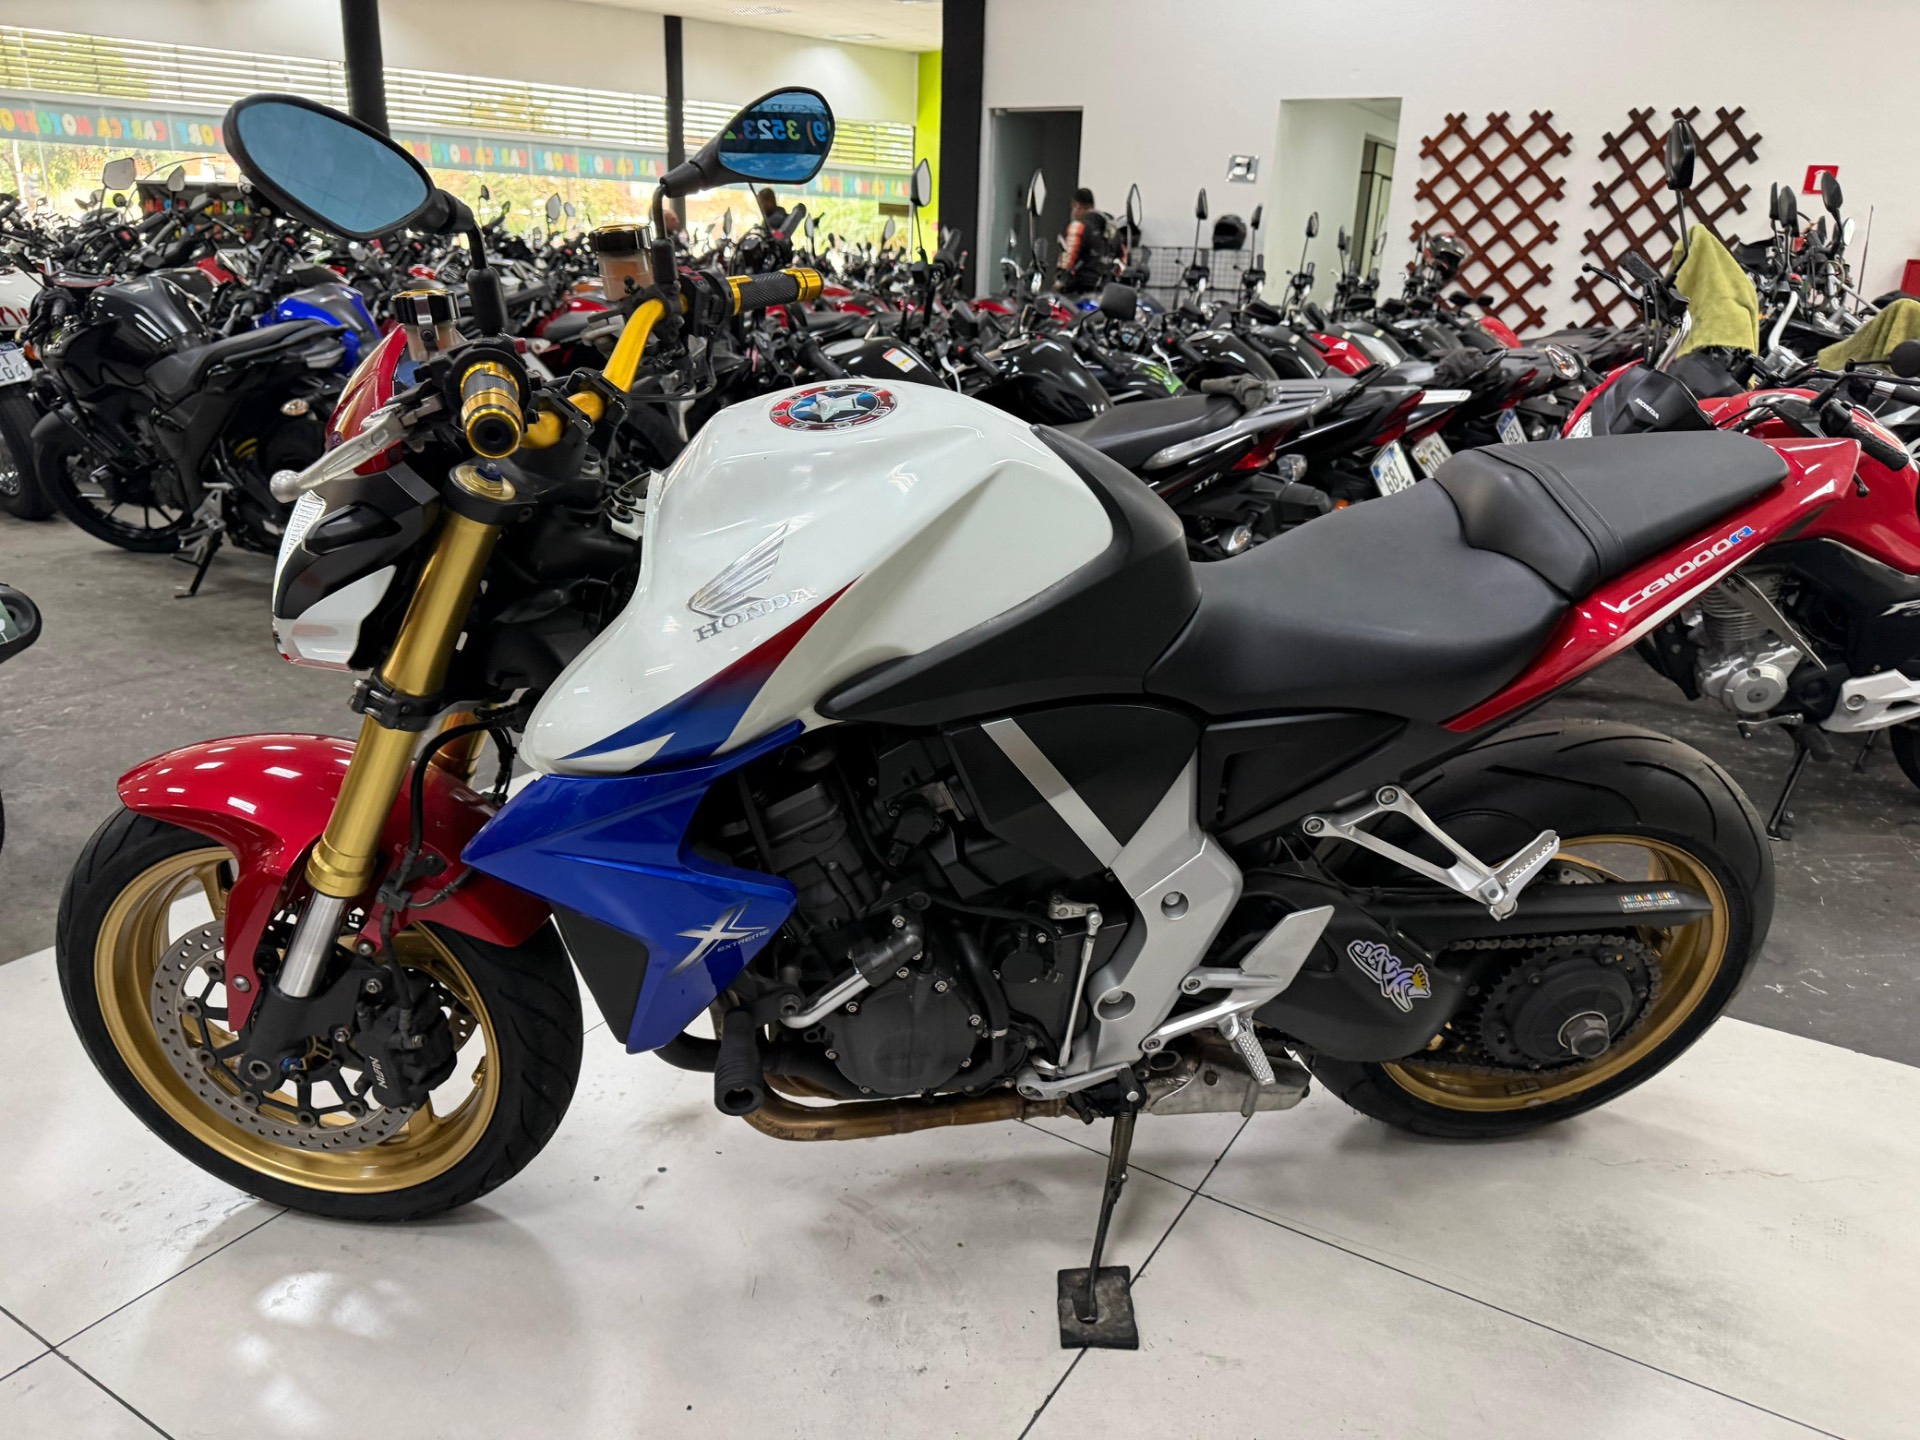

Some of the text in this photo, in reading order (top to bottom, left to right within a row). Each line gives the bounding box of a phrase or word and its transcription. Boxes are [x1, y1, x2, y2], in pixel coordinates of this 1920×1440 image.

[1634, 397, 1660, 420] HONDA
[1602, 525, 1756, 614] CB1000R
[692, 587, 819, 643] HONDA
